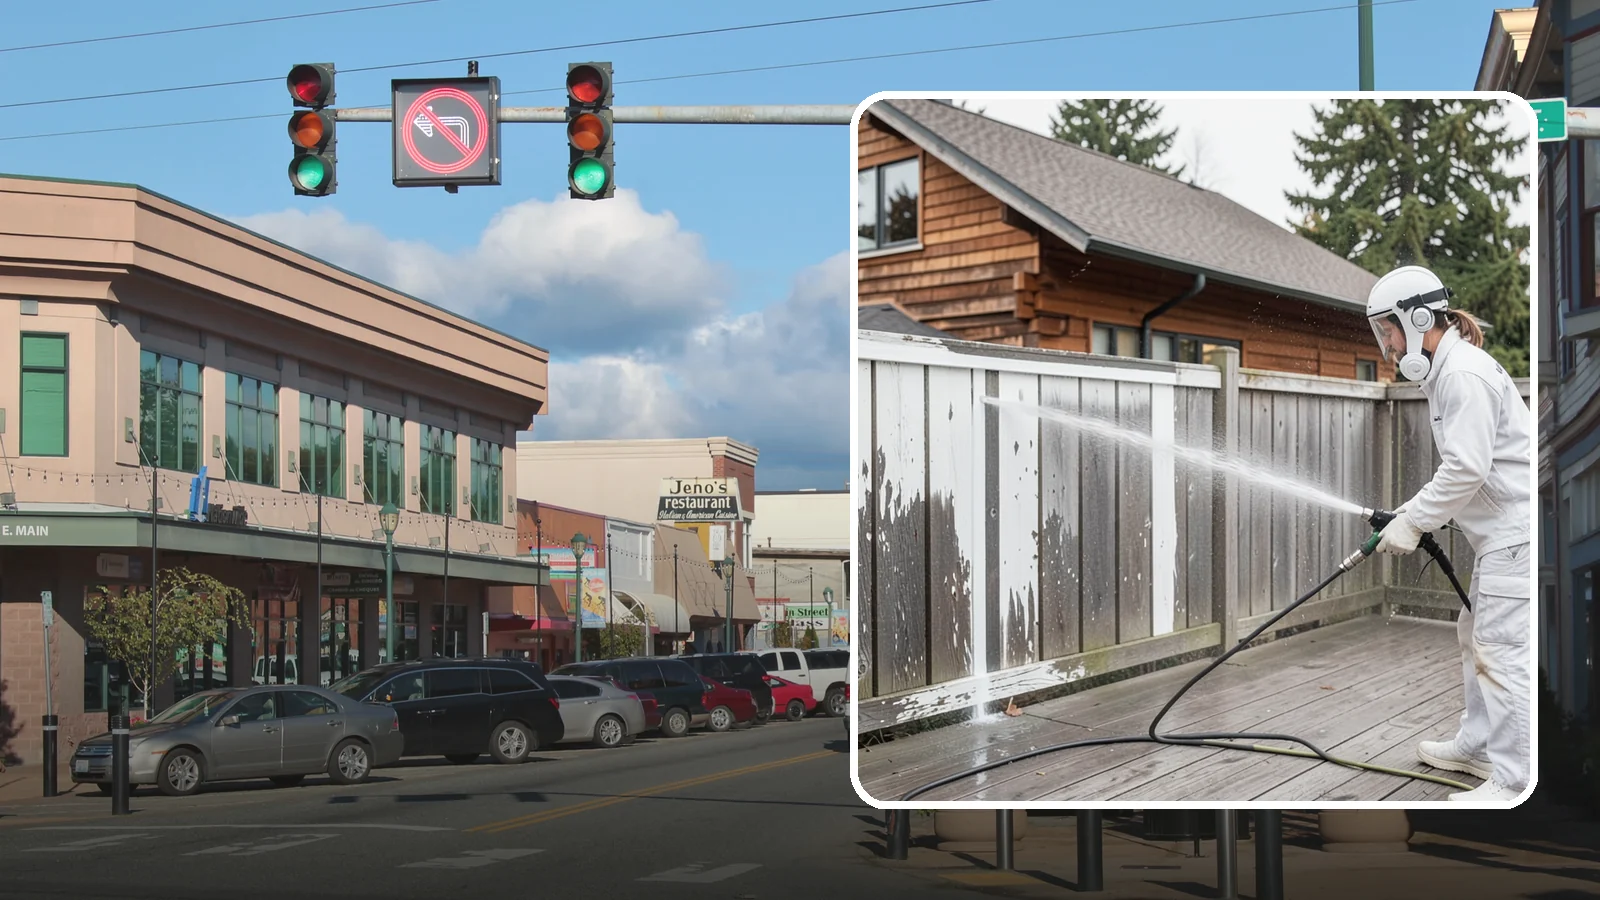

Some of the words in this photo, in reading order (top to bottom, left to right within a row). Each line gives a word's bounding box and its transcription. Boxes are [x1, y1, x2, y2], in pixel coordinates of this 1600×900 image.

[669, 480, 728, 494] Jeno's
[665, 496, 731, 509] restaurant
[658, 510, 681, 520] Italian
[686, 510, 715, 519] American
[715, 509, 738, 519] Cuisine
[2, 525, 13, 536] E.
[15, 525, 49, 536] MAIN
[797, 607, 828, 617] Street
